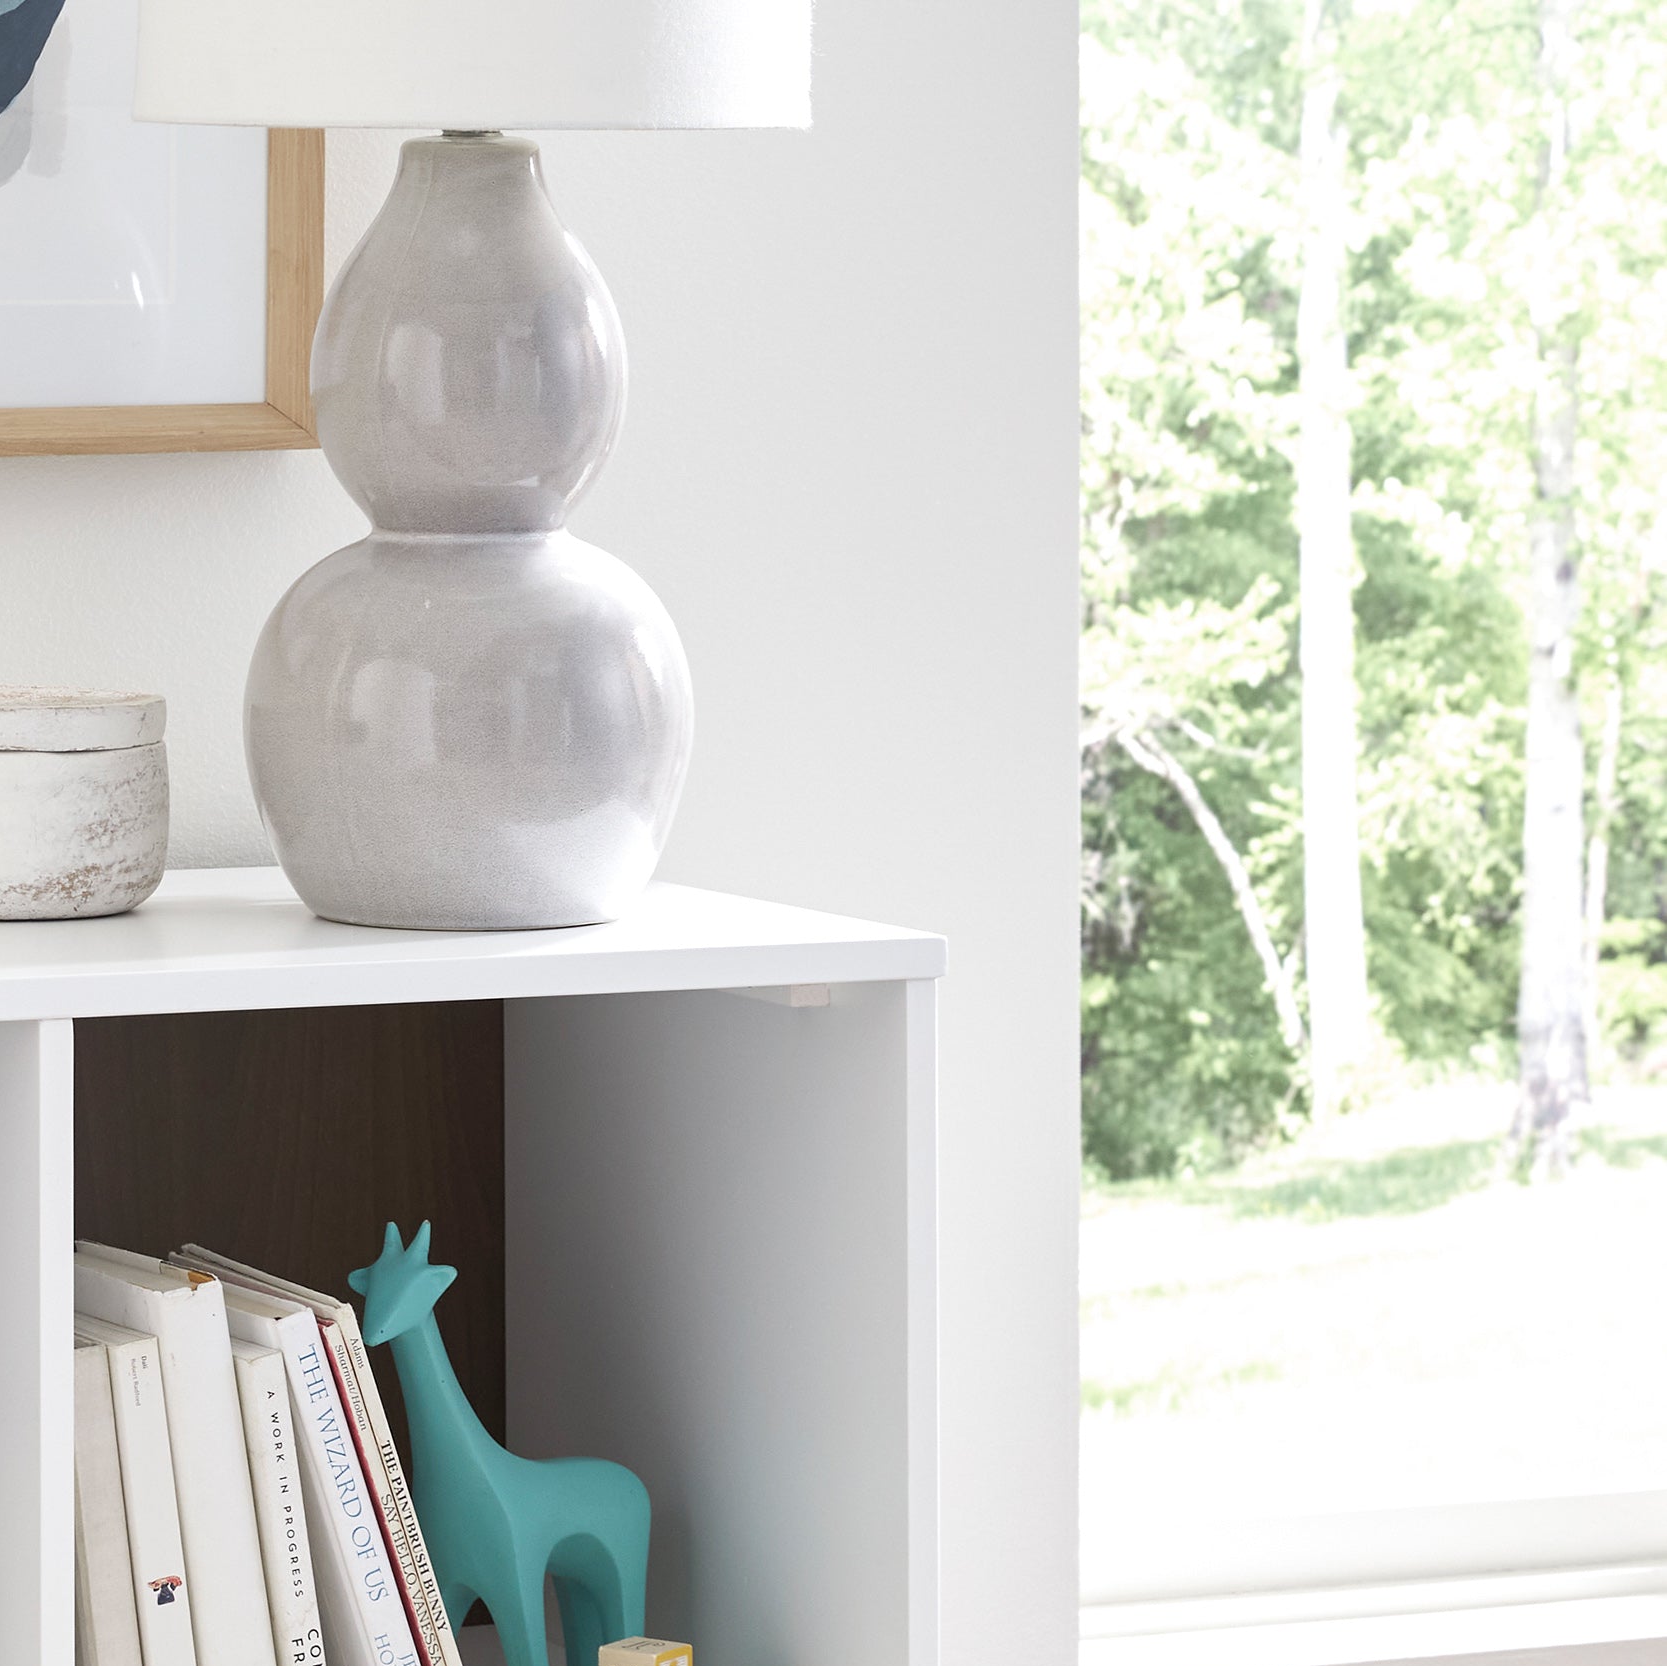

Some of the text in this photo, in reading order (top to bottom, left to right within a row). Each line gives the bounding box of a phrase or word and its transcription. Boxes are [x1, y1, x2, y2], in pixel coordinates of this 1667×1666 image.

[334, 1343, 367, 1432] Sharmat/Hoban
[349, 1338, 365, 1369] Adams
[267, 1390, 304, 1598] A WORK IN PROGRESS
[297, 1343, 390, 1602] THE WIZARD OF US
[380, 1439, 449, 1632] THE PAINTBRUSH BUNNY
[380, 1493, 443, 1666] SAY HELLO, VANESSA
